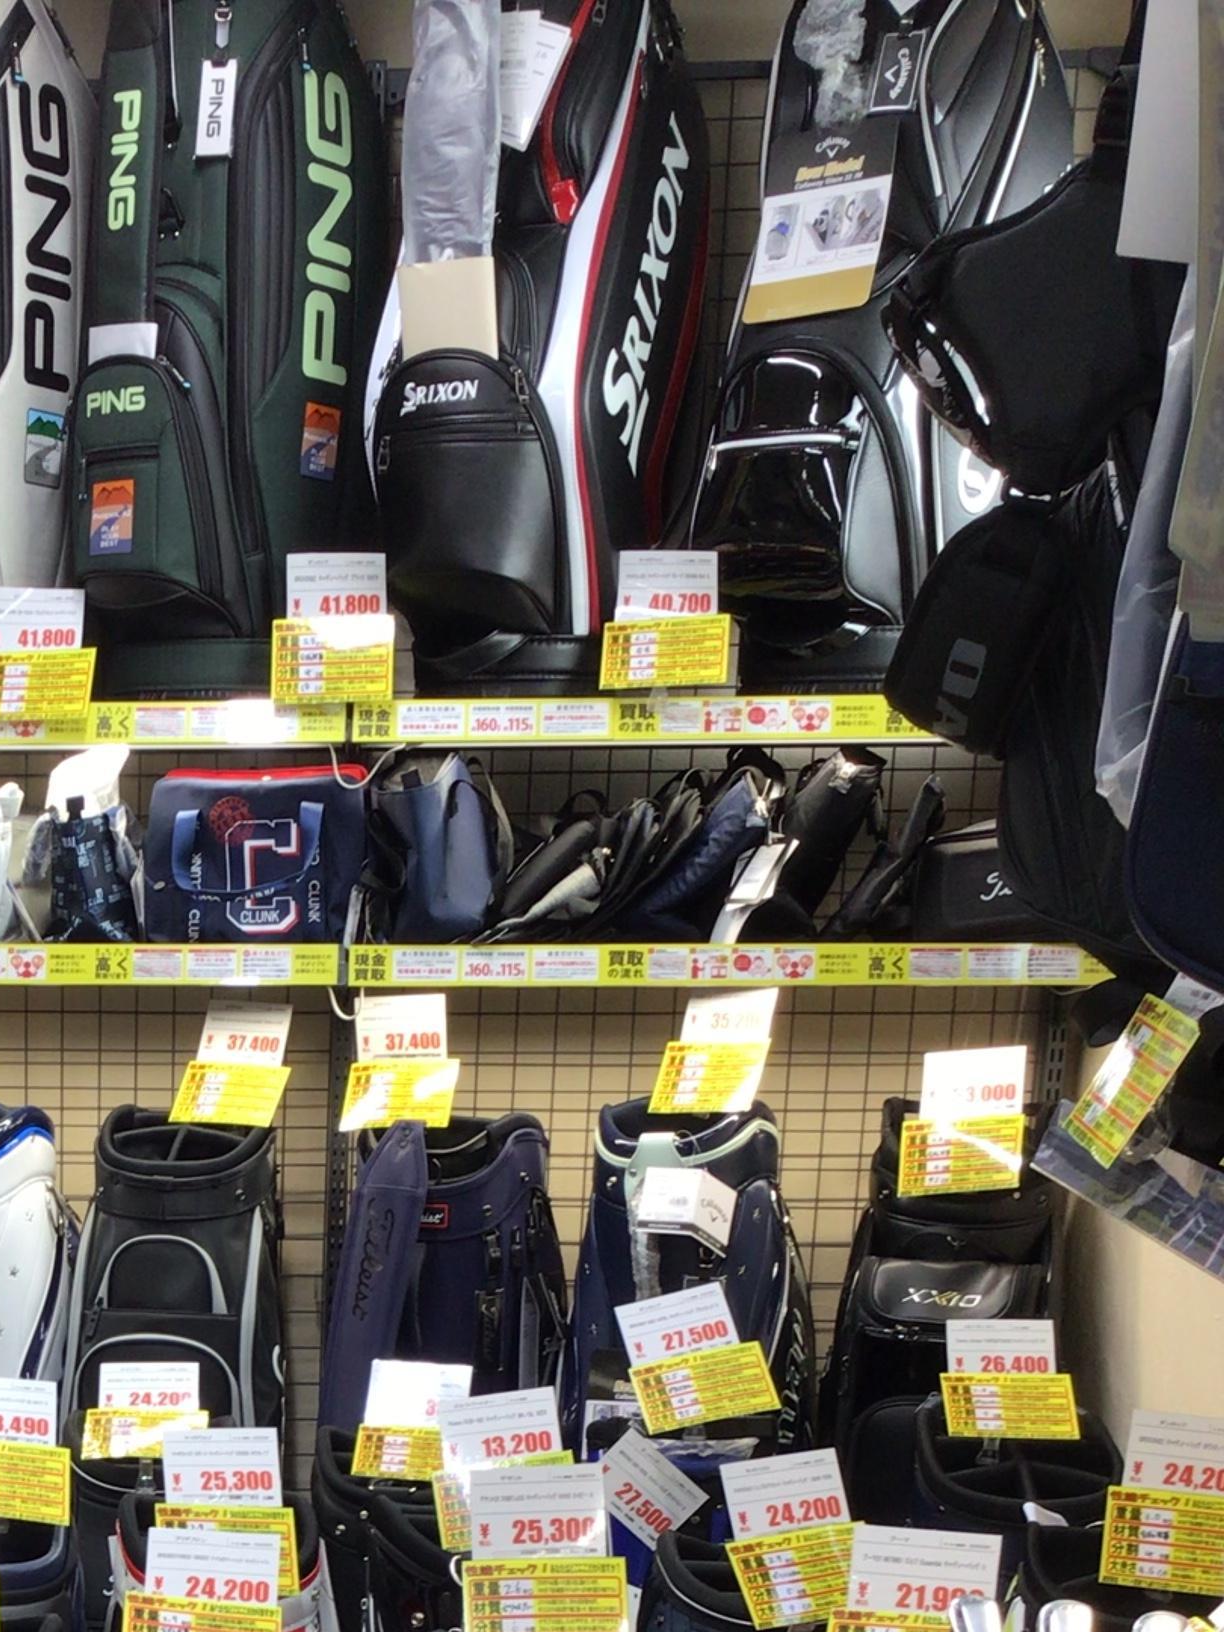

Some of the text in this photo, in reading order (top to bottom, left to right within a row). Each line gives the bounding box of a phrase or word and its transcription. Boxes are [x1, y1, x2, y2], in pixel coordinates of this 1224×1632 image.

[205, 77, 226, 138] PING
[106, 89, 143, 231] PING
[20, 81, 74, 393] PING
[301, 71, 355, 386] PING
[603, 111, 693, 477] SRIXON
[86, 385, 145, 417] PING
[400, 379, 479, 416] SRIXON
[320, 595, 381, 615] 41,800
[18, 628, 76, 649] 41,800
[240, 910, 280, 923] CLUNK
[308, 879, 321, 923] CLUNK
[385, 1031, 441, 1052] 37,400
[902, 1286, 983, 1308] XXIO
[662, 1320, 729, 1351] 27,500
[981, 1355, 1048, 1374] 26,400
[482, 1430, 552, 1460] 13,200
[200, 1471, 273, 1492] 25,300
[614, 1482, 673, 1536] 27,500
[765, 1495, 842, 1528] 24,200
[185, 1576, 270, 1603] 24,200
